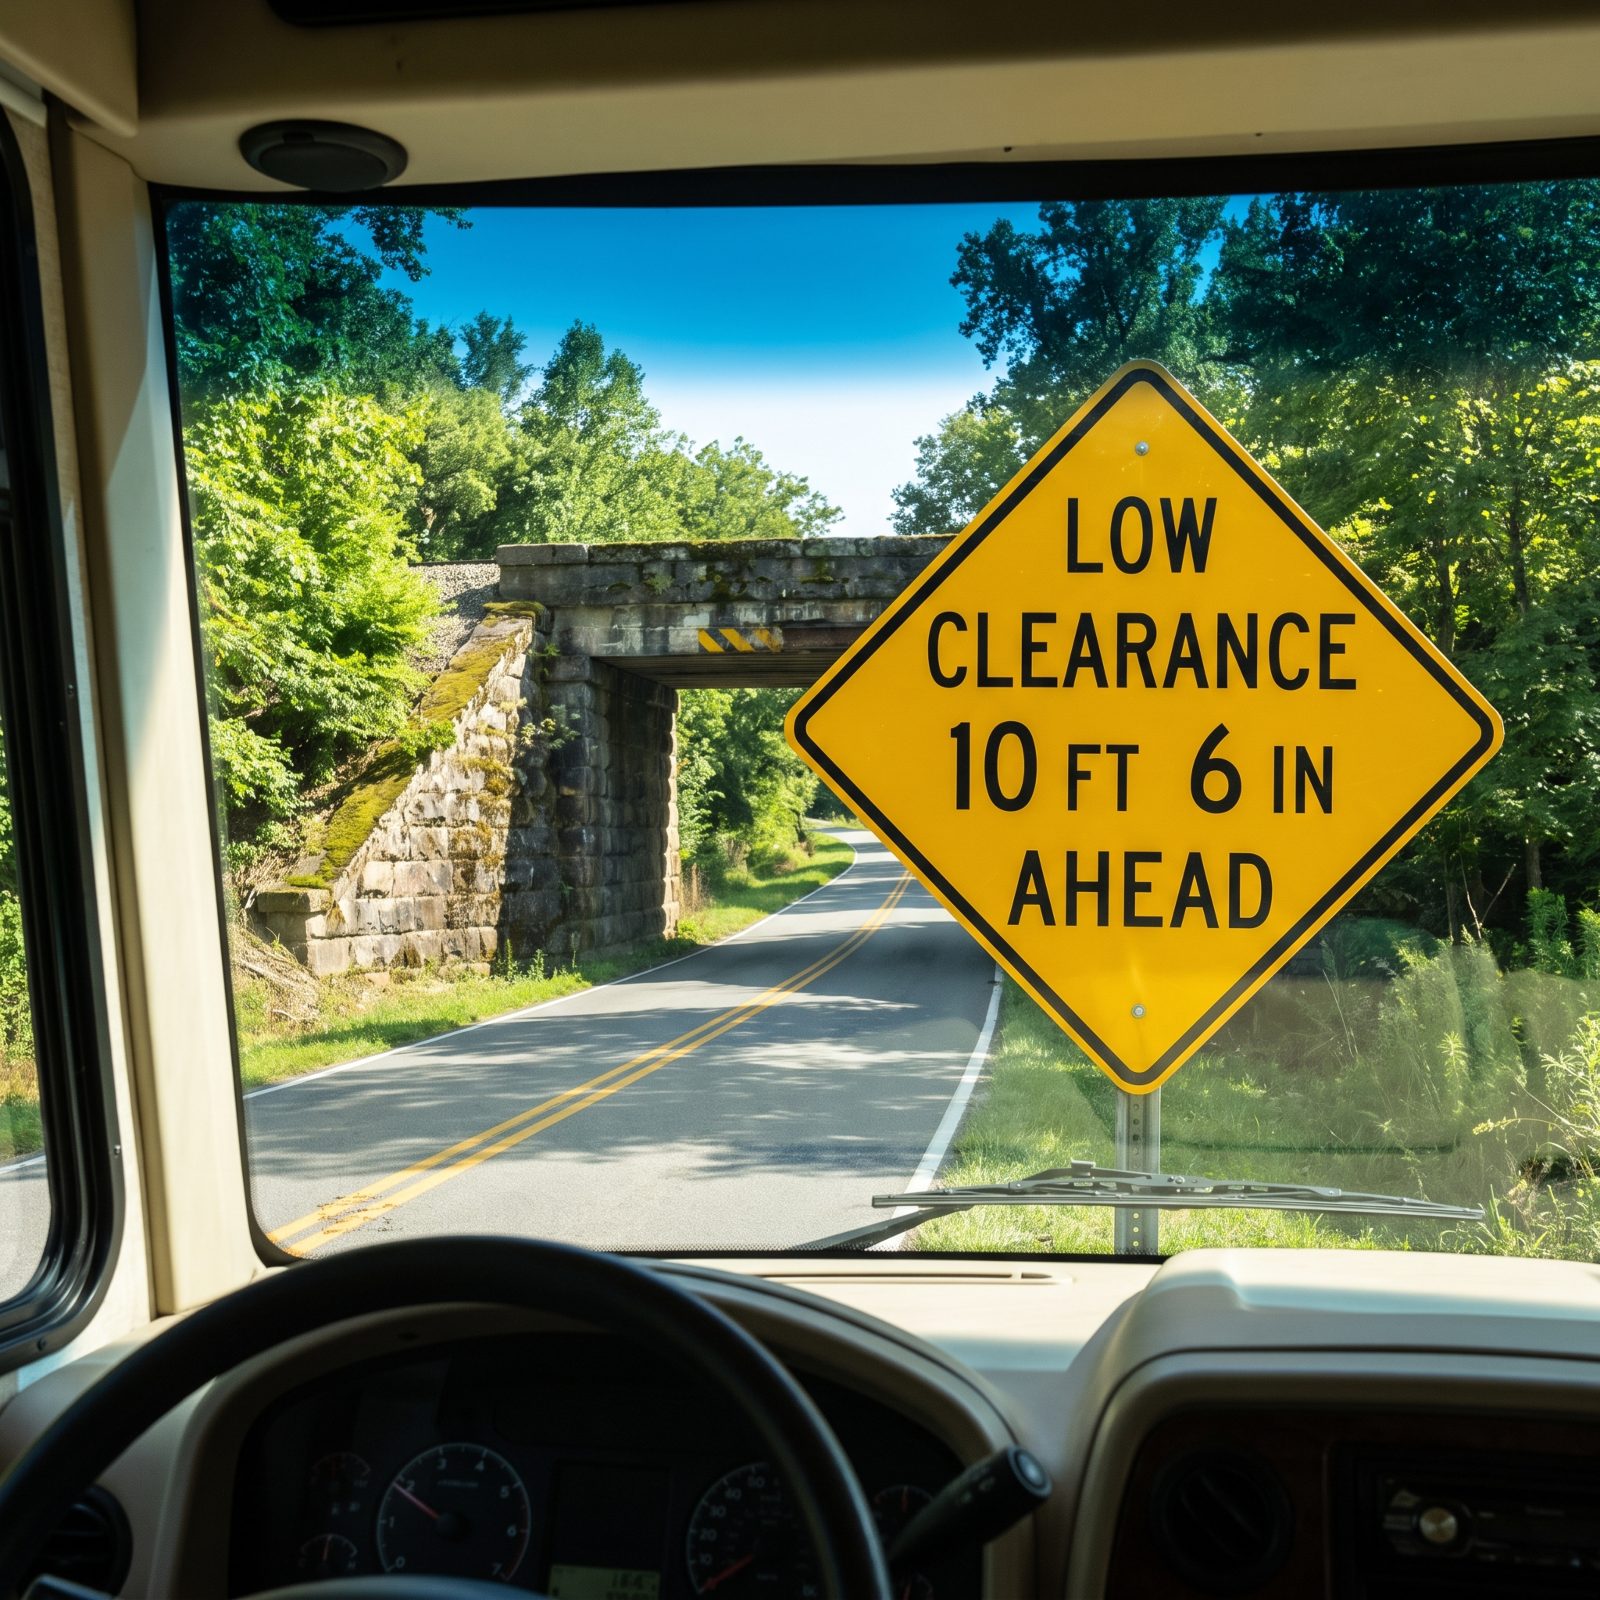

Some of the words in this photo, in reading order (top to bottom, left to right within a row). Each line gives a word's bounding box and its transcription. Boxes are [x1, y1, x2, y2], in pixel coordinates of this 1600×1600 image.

[1067, 496, 1218, 574] LOW
[927, 611, 1357, 690] CLEARANCE
[950, 720, 1038, 812] 10
[1067, 743, 1140, 812] FT
[1190, 723, 1242, 814] 6
[1273, 745, 1333, 814] IN
[1007, 849, 1273, 929] AHEAD
[436, 1457, 446, 1471] 3
[474, 1458, 485, 1471] 4
[404, 1480, 416, 1492] 2
[499, 1485, 510, 1499] 5
[506, 1524, 517, 1537] 6
[699, 1528, 717, 1542] 20
[394, 1555, 406, 1569] 0
[699, 1552, 713, 1566] 10
[491, 1563, 503, 1577] 7
